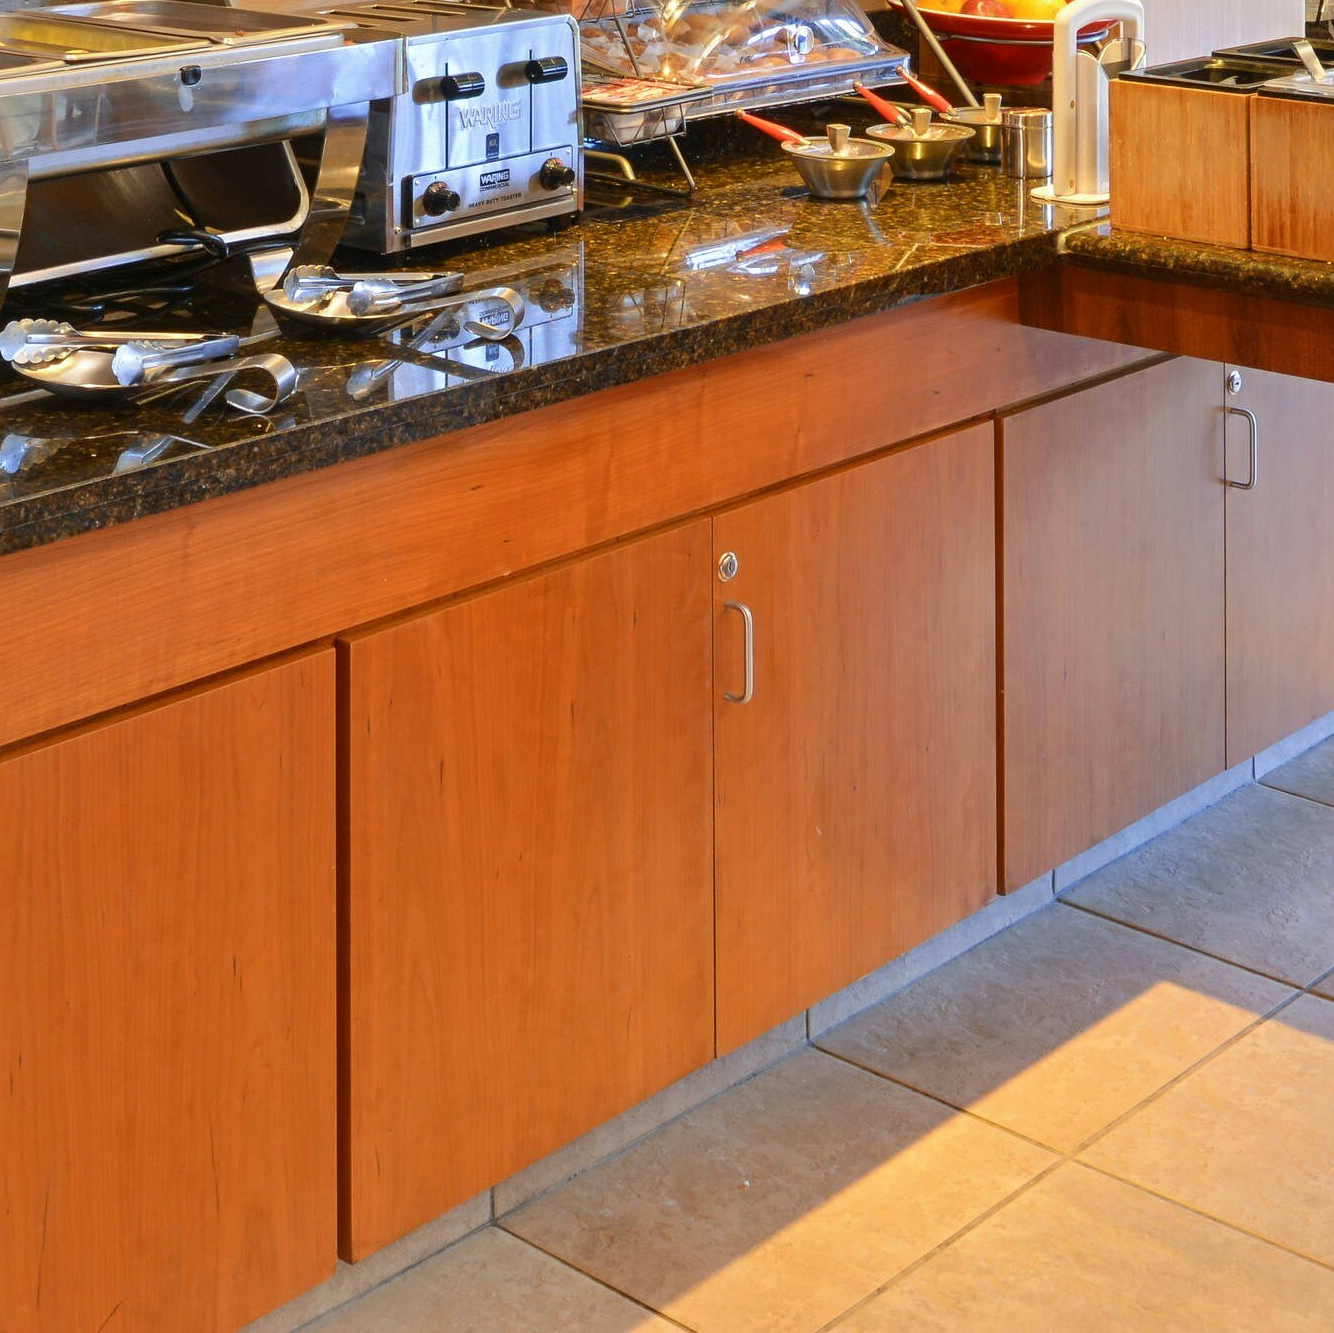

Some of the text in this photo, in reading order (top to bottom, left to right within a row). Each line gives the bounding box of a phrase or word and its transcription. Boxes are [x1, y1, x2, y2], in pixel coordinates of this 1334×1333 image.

[458, 99, 521, 130] WARING
[480, 170, 509, 184] WARING
[479, 182, 510, 192] COMMERCIAL
